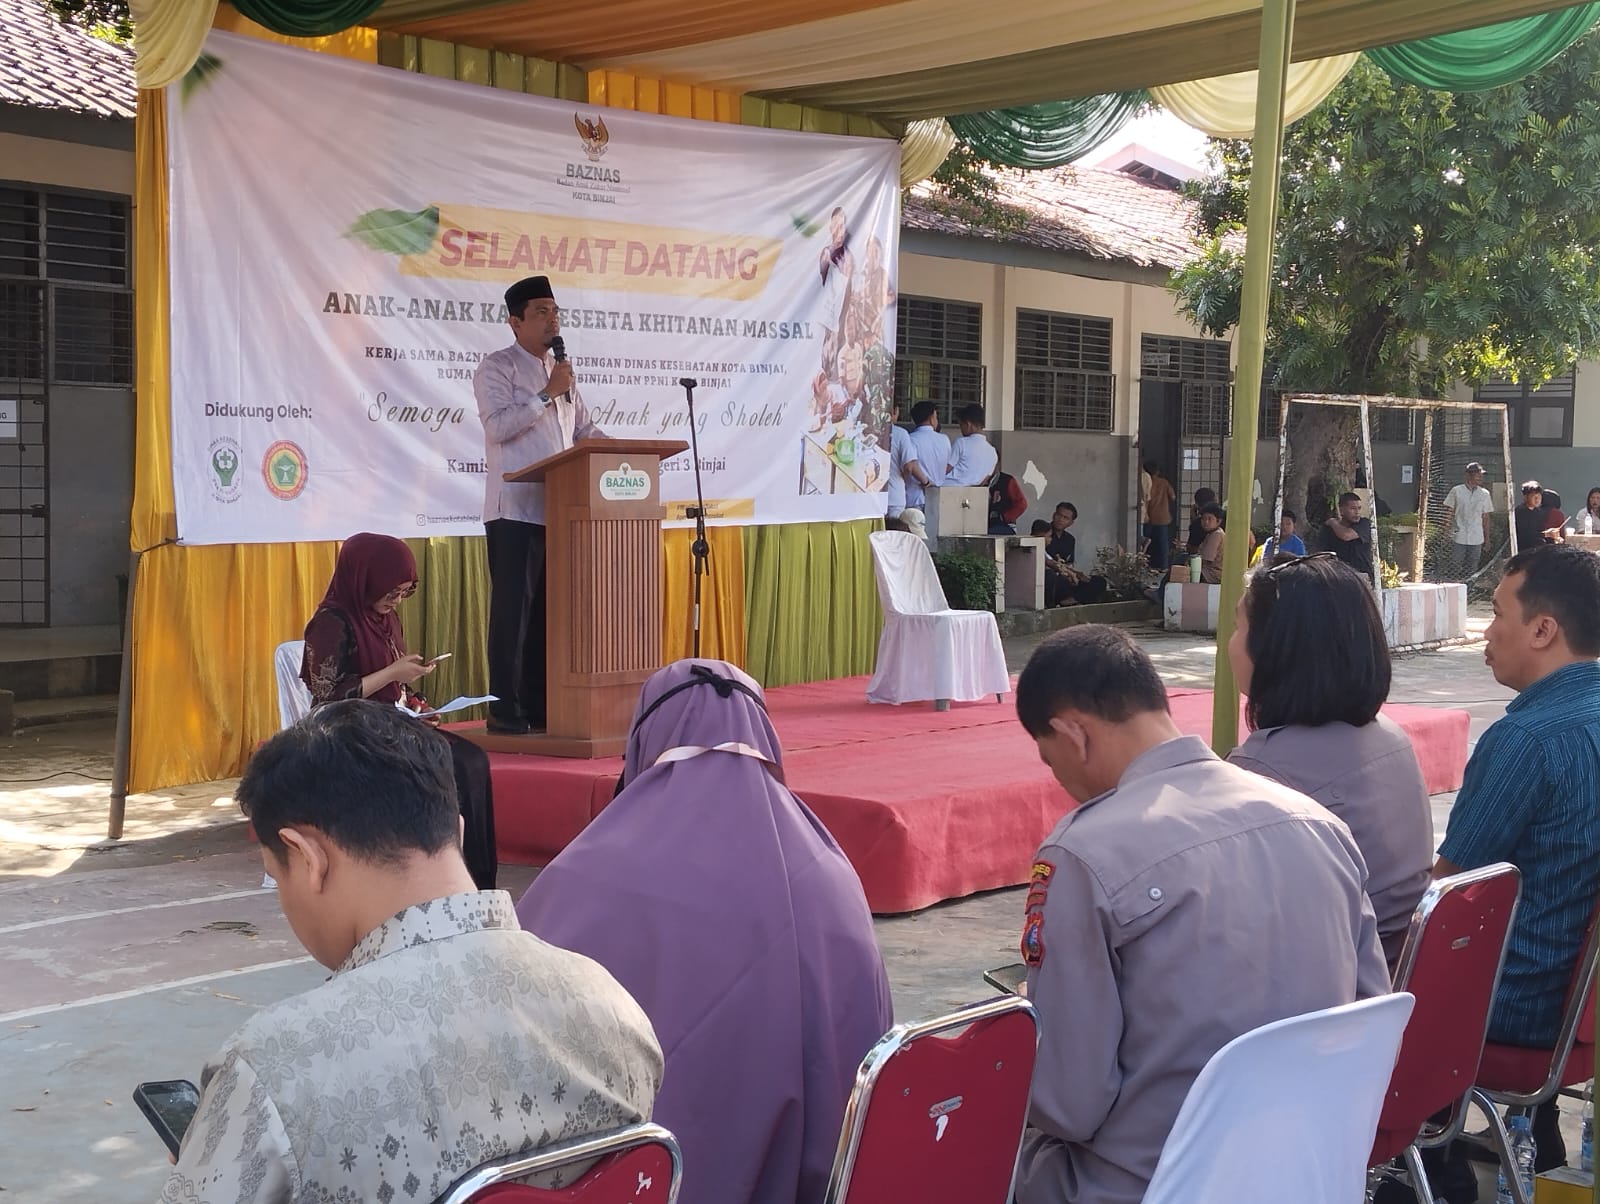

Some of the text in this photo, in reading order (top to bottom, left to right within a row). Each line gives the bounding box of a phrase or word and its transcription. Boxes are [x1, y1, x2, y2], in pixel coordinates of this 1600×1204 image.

[566, 163, 621, 183] BAZNAS
[439, 228, 759, 281] SELAMAT DATANG
[323, 291, 474, 322] ANAK-ANAK
[559, 307, 634, 331] ESERTA
[638, 312, 738, 337] KHITANAN
[742, 319, 814, 340] MASSAL
[365, 346, 406, 361] KERJA
[410, 349, 445, 362] SAMA
[448, 351, 488, 363] BAZNA
[576, 356, 621, 369] DENGAN
[624, 358, 657, 370] DINAS
[659, 359, 719, 373] KESEHATAN
[721, 361, 746, 373] KOTA
[437, 368, 475, 380] RUMA
[577, 374, 613, 386] BINJAI
[619, 374, 642, 386] DAN
[644, 375, 669, 387] PPNI
[701, 377, 732, 389] BINJAI
[205, 402, 312, 422] Didukung Oleh:
[590, 399, 650, 427] Anak
[683, 458, 690, 471] 3
[606, 477, 645, 488] BAZNAS
